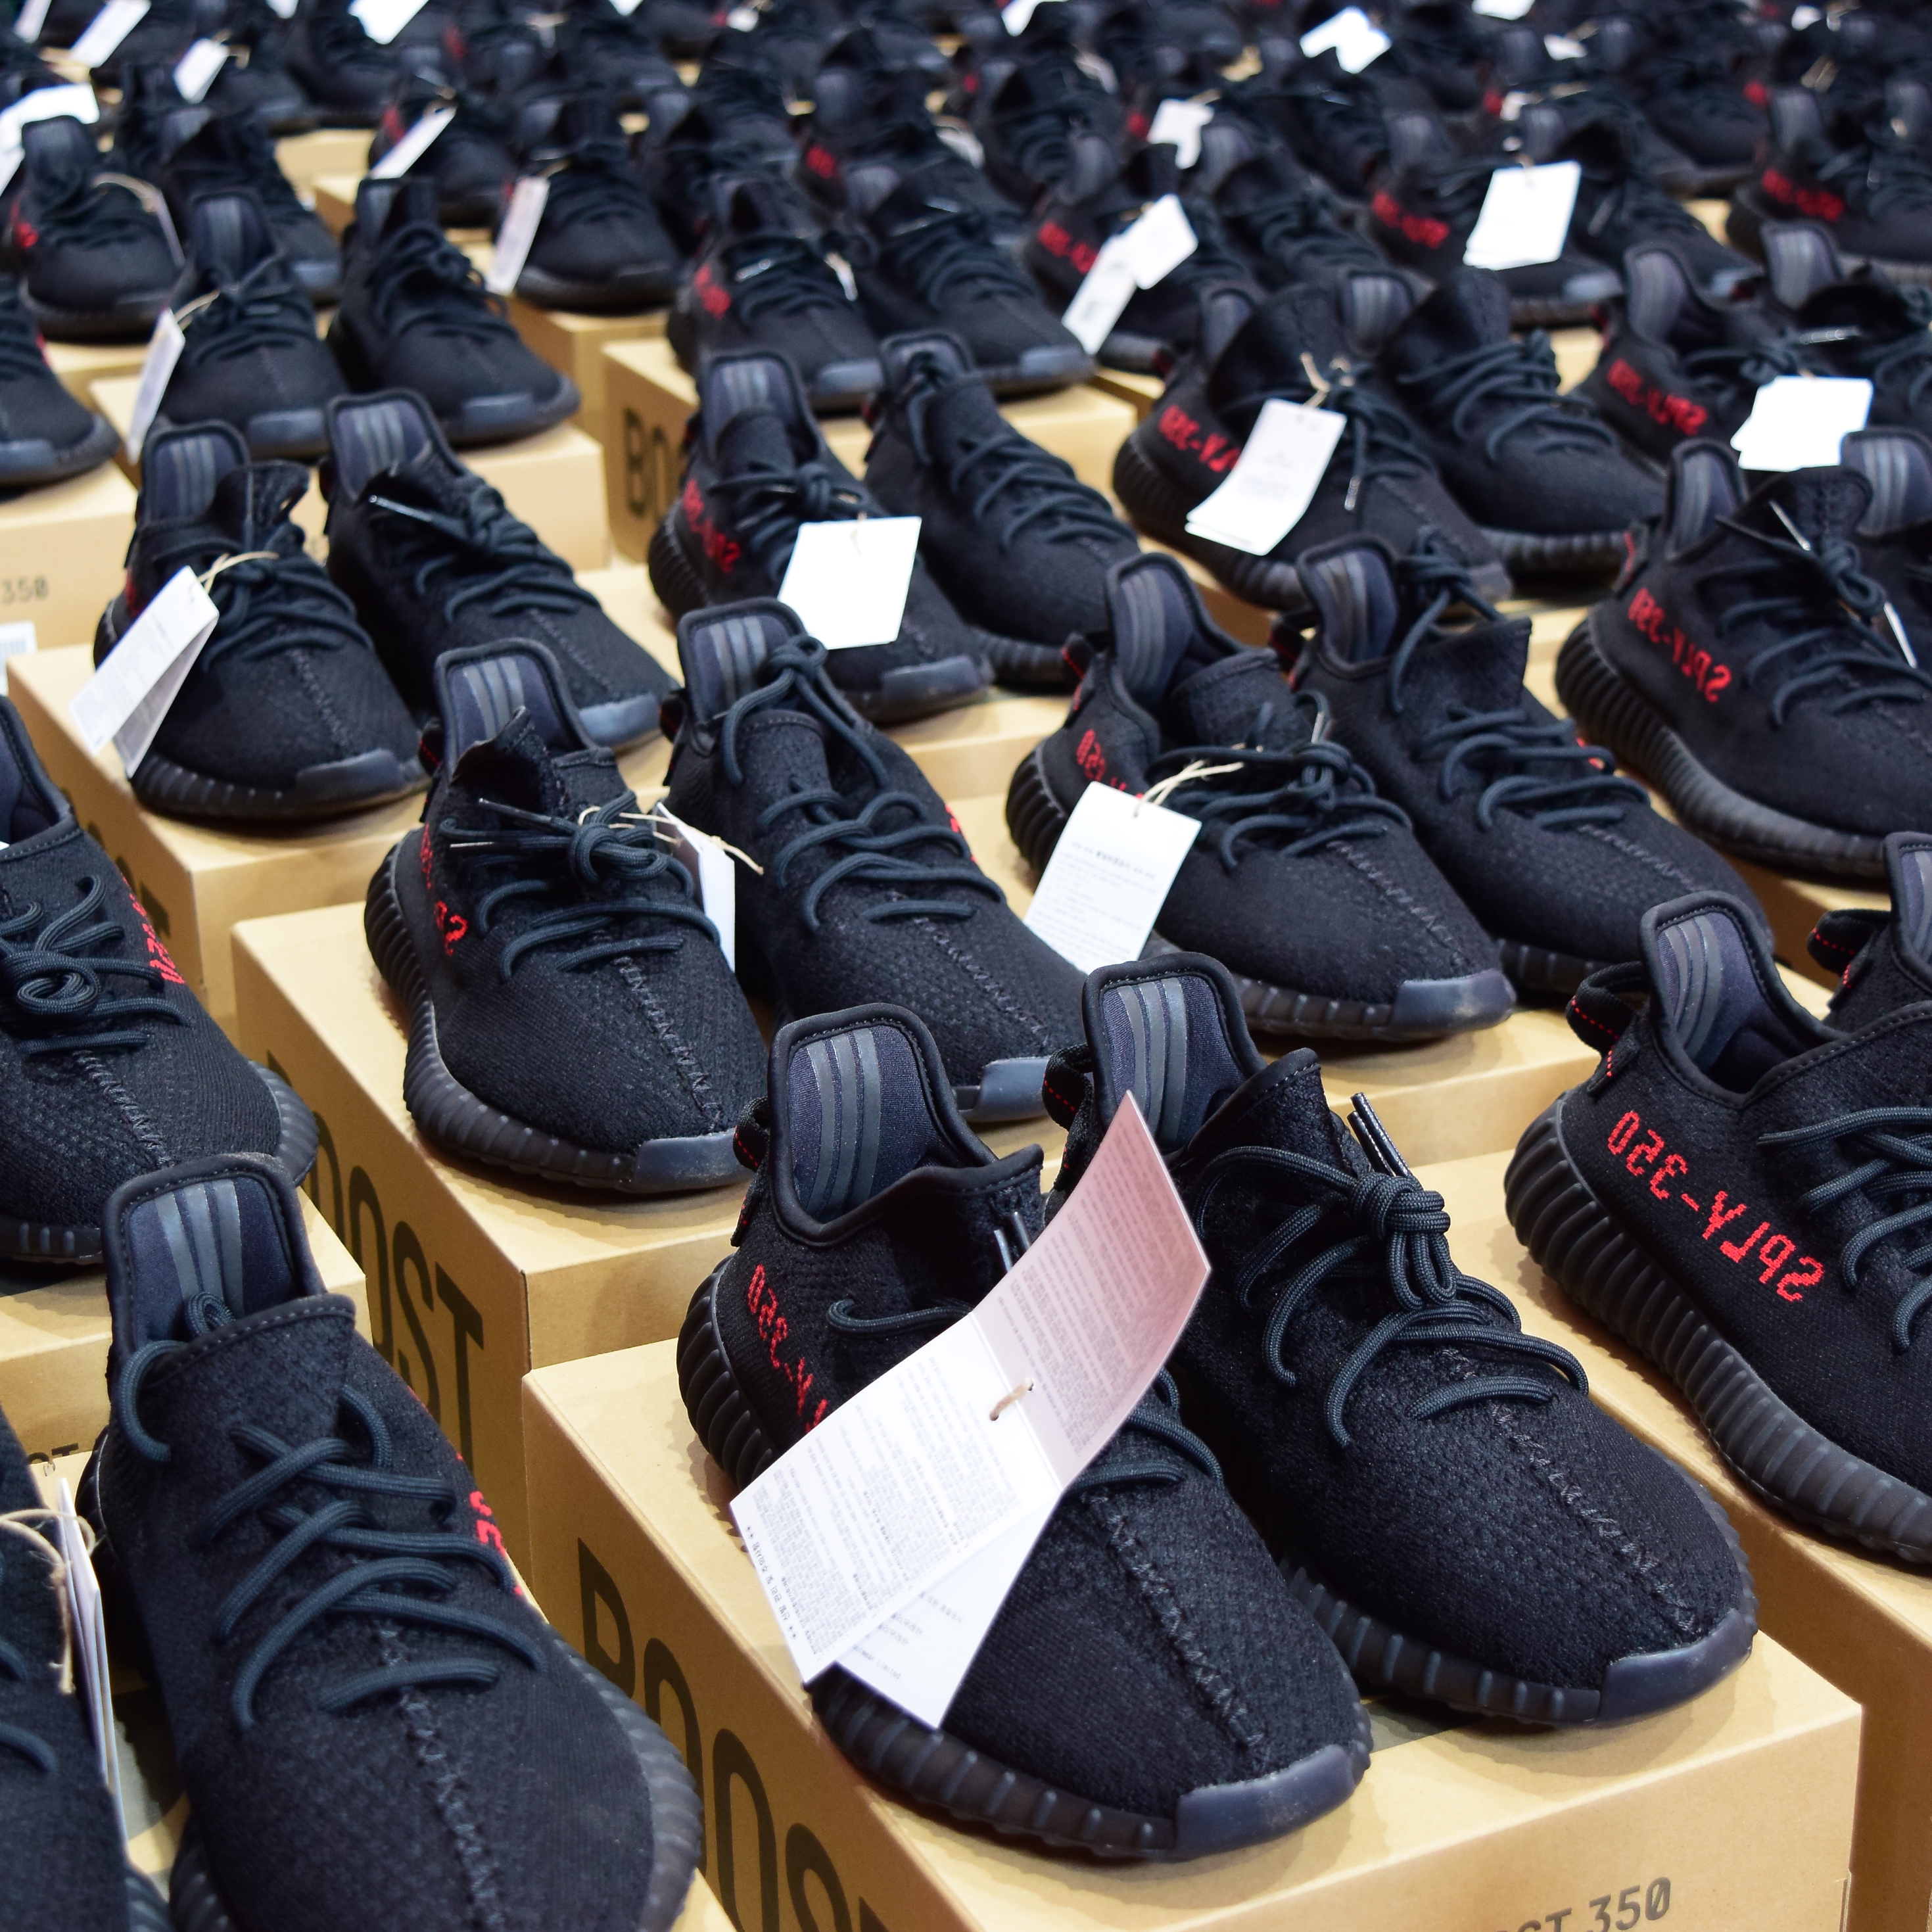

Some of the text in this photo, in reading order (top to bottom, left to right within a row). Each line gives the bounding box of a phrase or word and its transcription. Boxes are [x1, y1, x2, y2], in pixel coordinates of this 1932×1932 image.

[751, 1541, 769, 1573] 주의사항
[769, 1585, 782, 1603] 관리
[778, 1603, 790, 1621] 신발
[1586, 1876, 1671, 1932] 350
